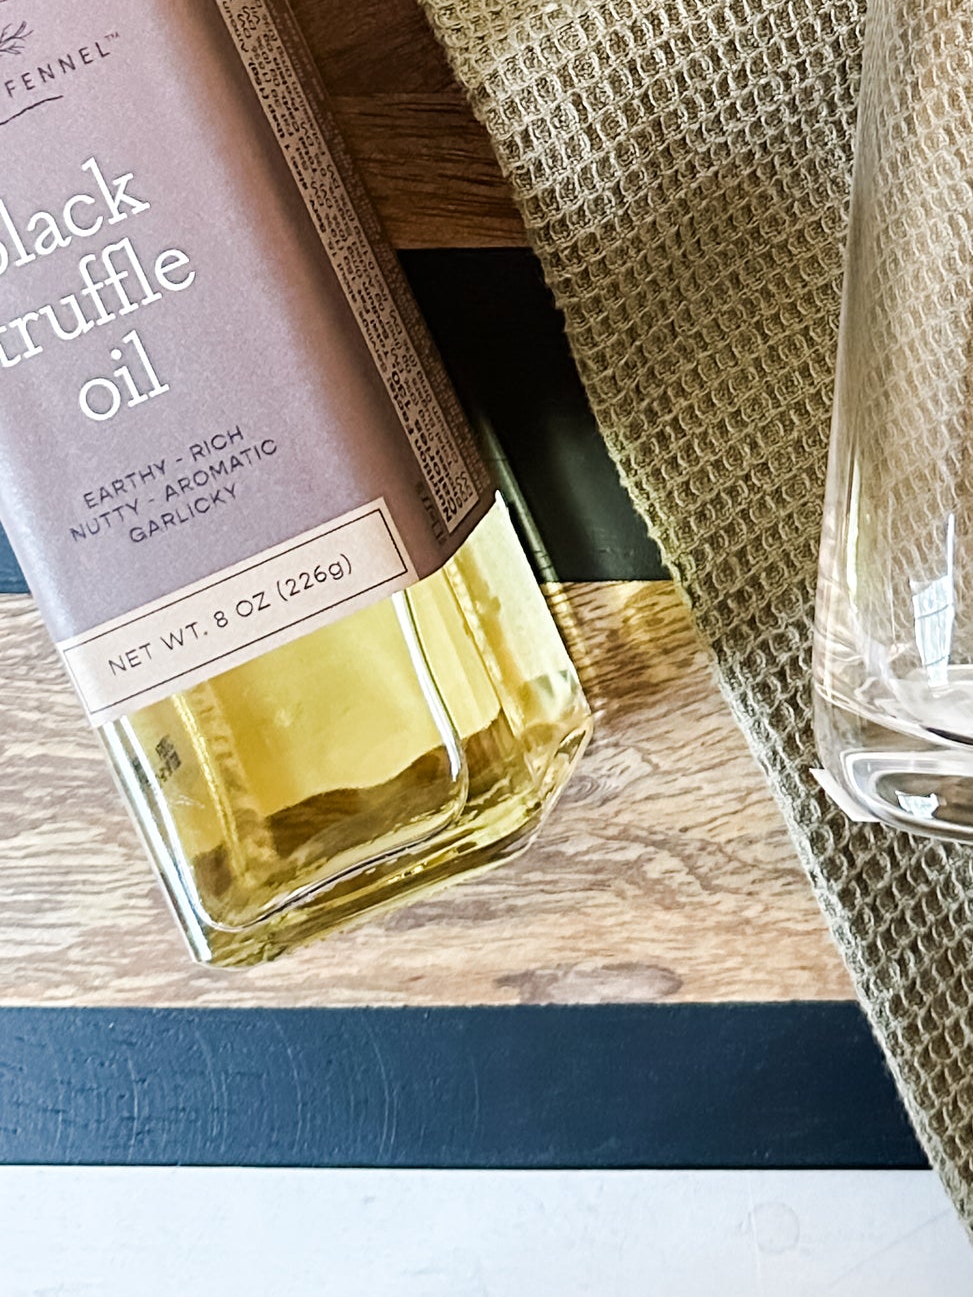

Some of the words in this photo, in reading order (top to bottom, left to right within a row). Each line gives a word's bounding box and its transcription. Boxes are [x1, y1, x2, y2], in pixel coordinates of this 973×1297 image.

[0, 156, 151, 276] lack
[78, 329, 170, 421] oil
[69, 498, 139, 543] NUTTY
[165, 438, 278, 501] AROMATIC
[83, 458, 166, 510] EARTHY
[189, 424, 245, 462] RICH
[129, 483, 237, 543] GARLICKY
[411, 415, 459, 518] Calories
[411, 435, 453, 524] Nutrition
[108, 642, 153, 676] NET
[160, 621, 209, 651] WT.
[213, 610, 229, 629] 8
[235, 591, 271, 618] OZ
[276, 553, 352, 602] (226g)
